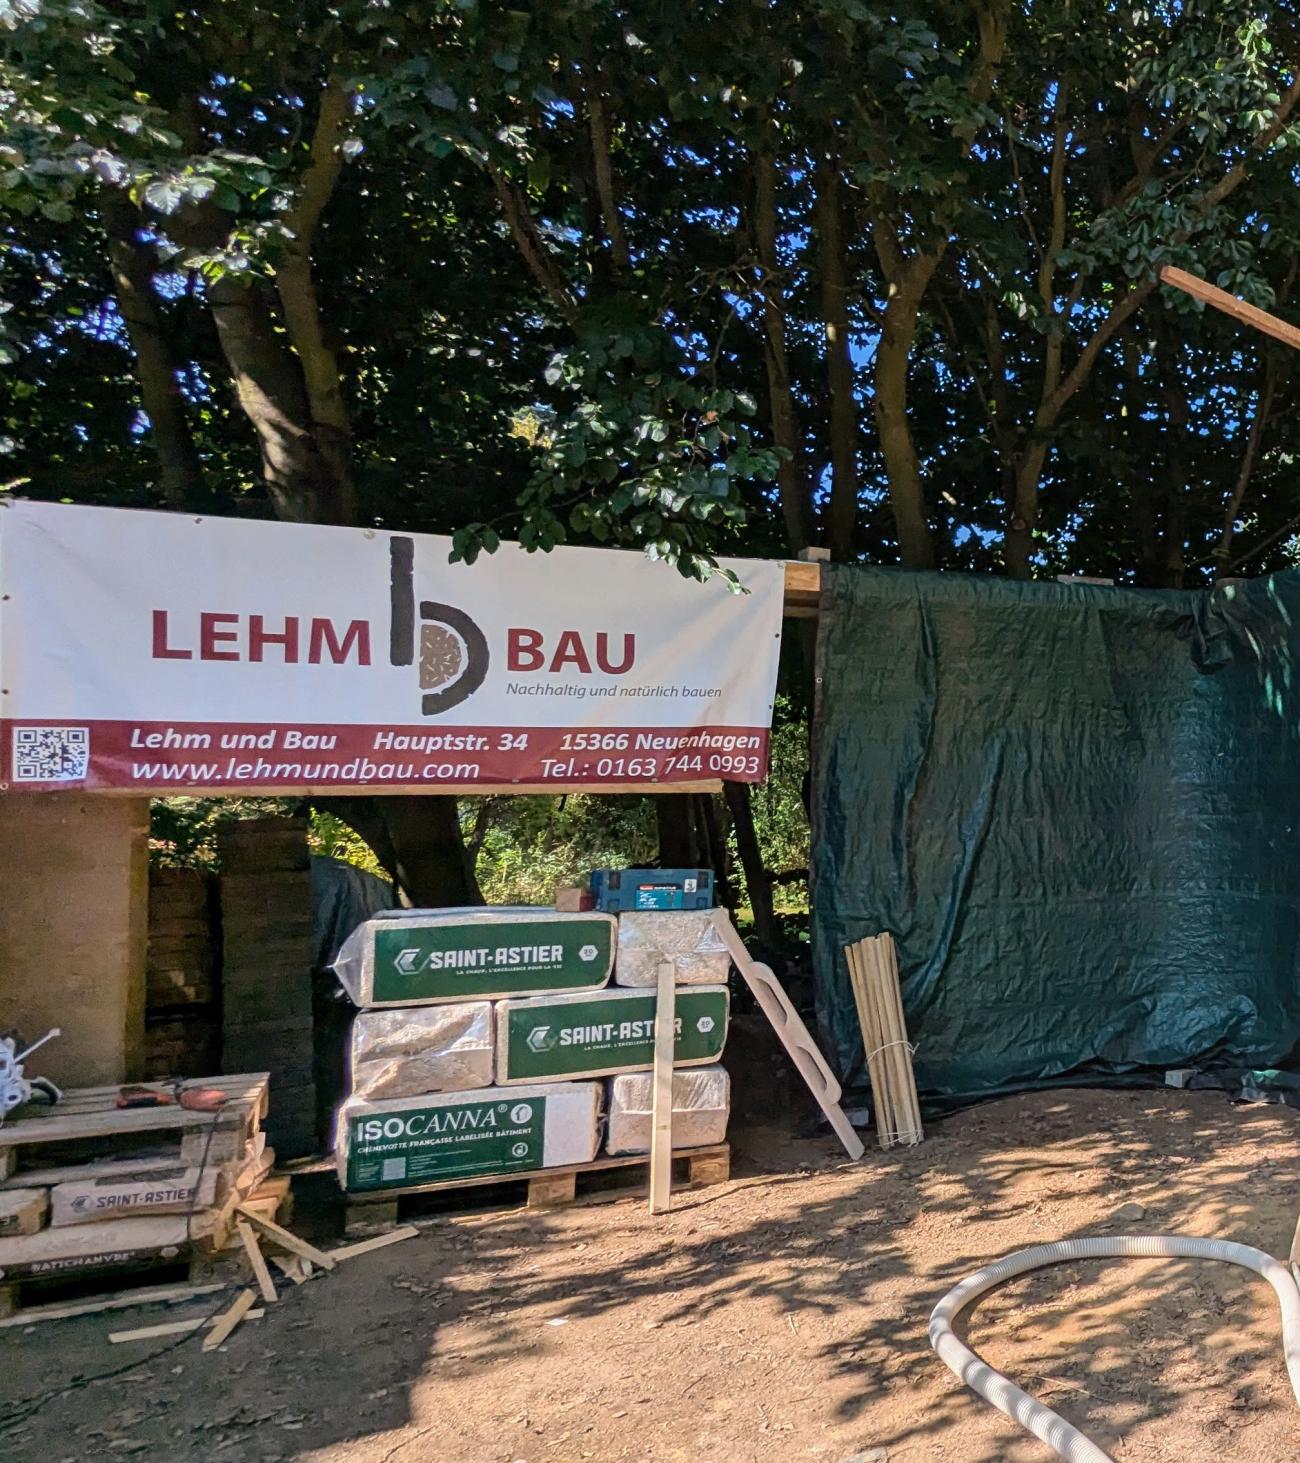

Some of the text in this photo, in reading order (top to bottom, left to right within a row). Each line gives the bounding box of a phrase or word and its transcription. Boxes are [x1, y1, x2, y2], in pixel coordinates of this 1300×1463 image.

[152, 610, 371, 666] LEHM
[507, 628, 636, 675] BAU
[506, 682, 722, 699] Nachhaltig und natürlich bauen
[130, 728, 761, 754] Lehm und Bau Hauptstr. 34 15366 Neuenhagen
[132, 757, 480, 780] www.lehmundbau.com
[540, 755, 760, 777] Tel.: 0163 744 0993
[430, 945, 563, 969] SAINT-ASTIER
[560, 1017, 682, 1046] SAINT-ASTR
